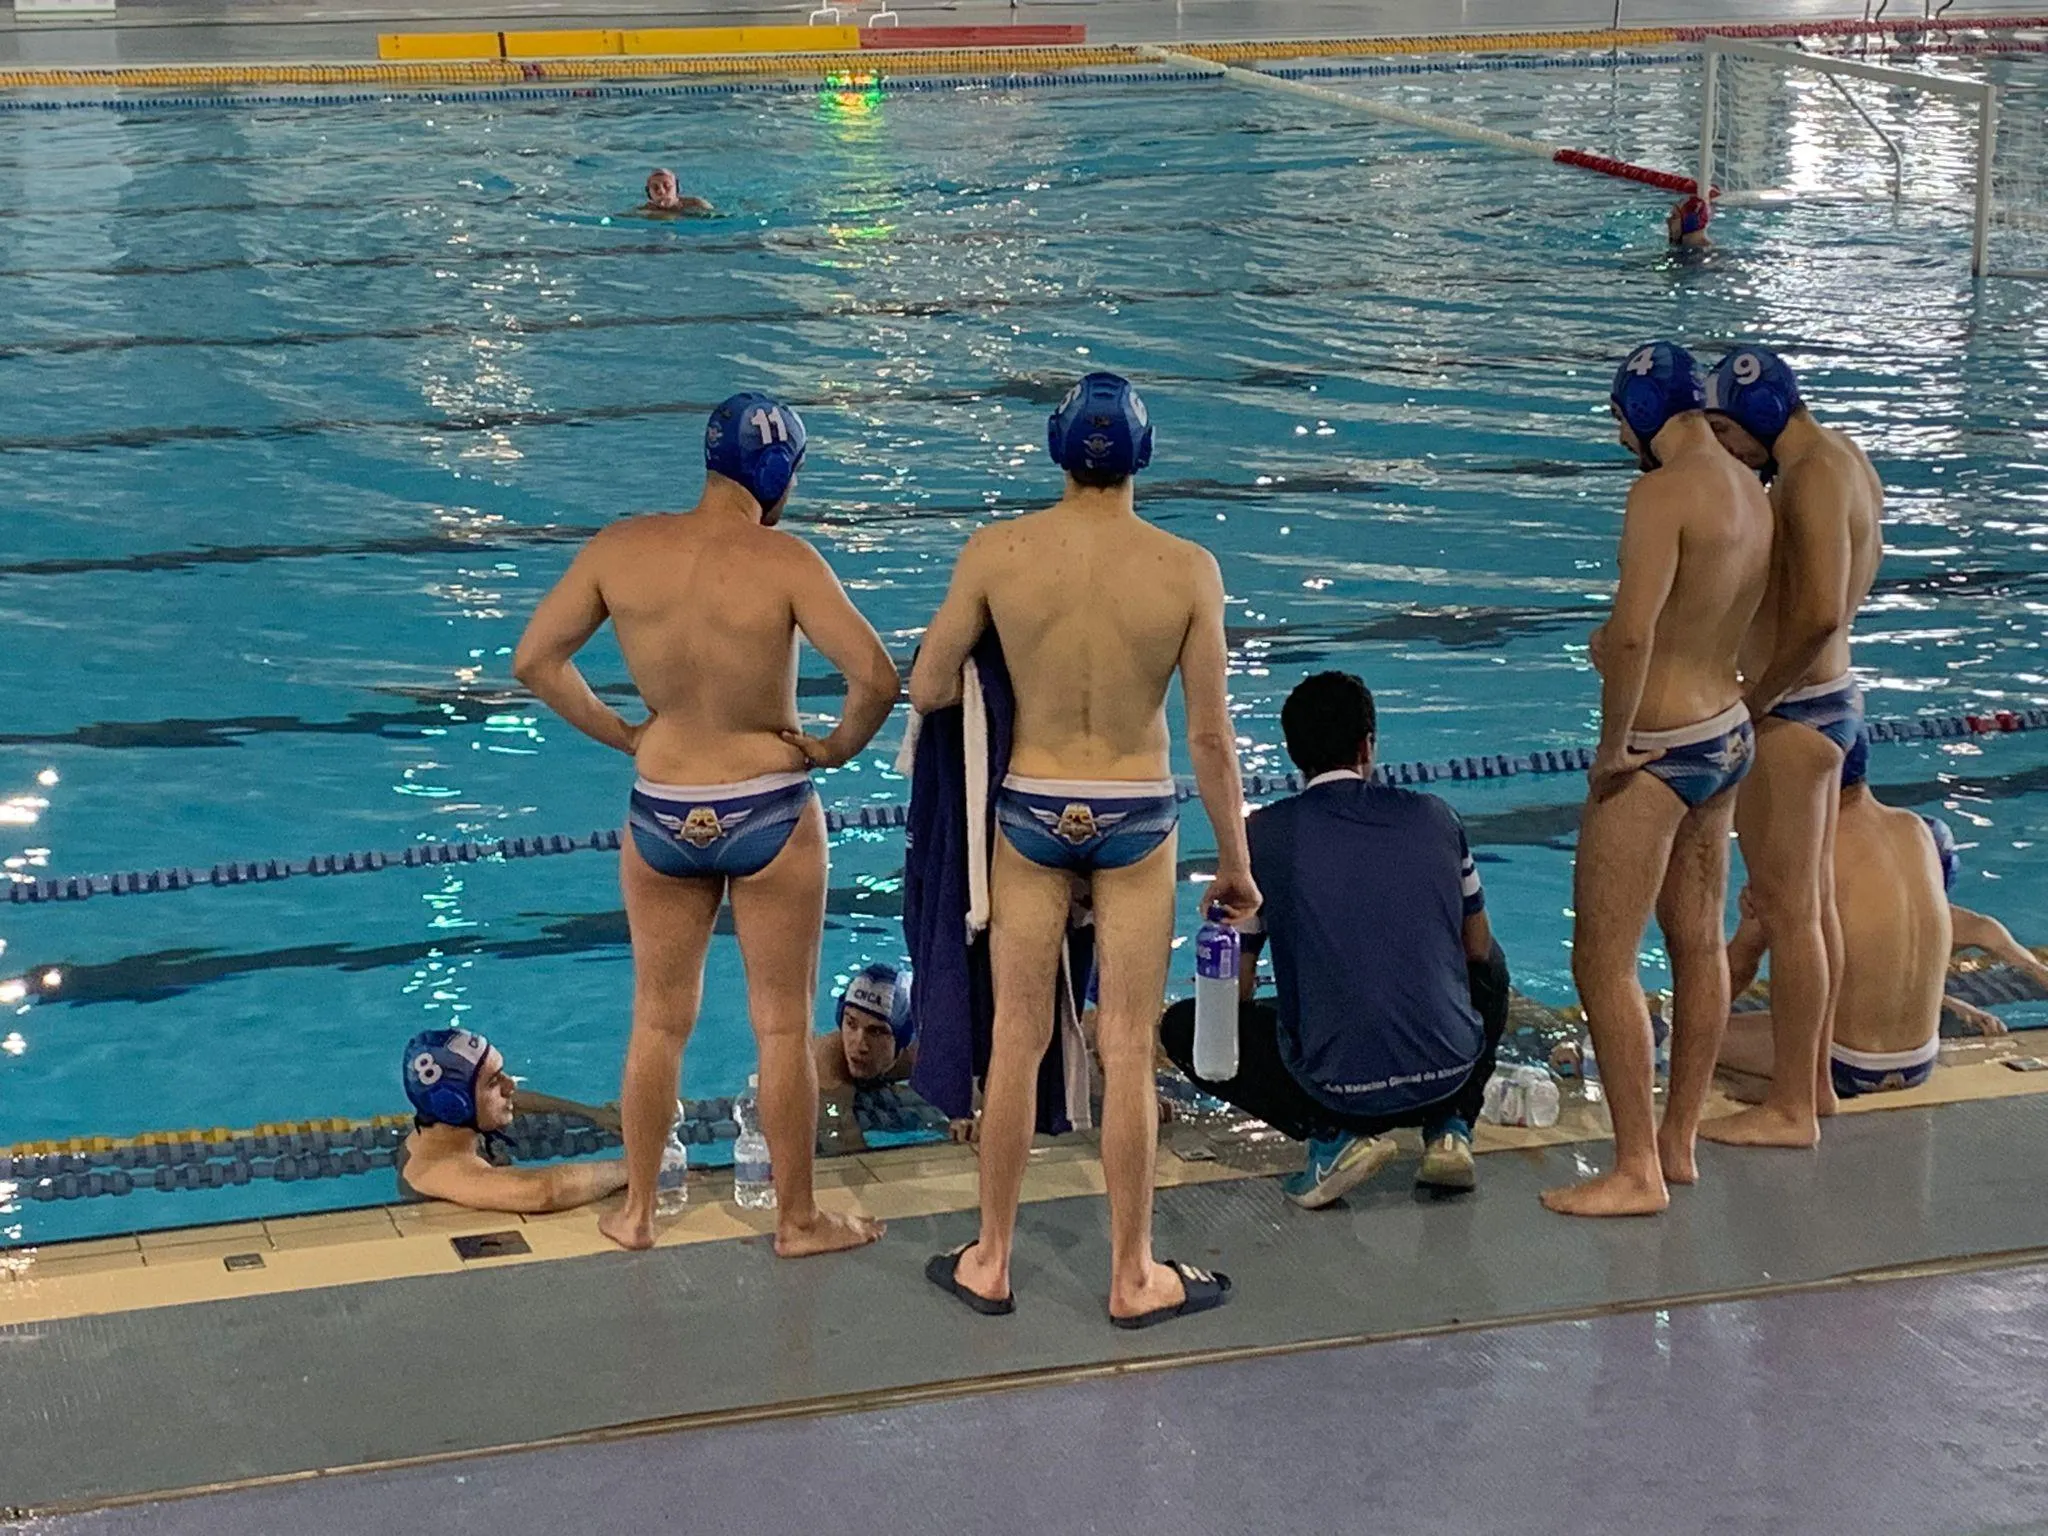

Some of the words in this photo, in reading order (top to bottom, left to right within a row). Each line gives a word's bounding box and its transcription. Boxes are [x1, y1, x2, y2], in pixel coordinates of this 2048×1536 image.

[1626, 347, 1655, 376] 4
[1733, 353, 1761, 385] 9
[750, 406, 788, 445] 11
[414, 1053, 443, 1085] 8
